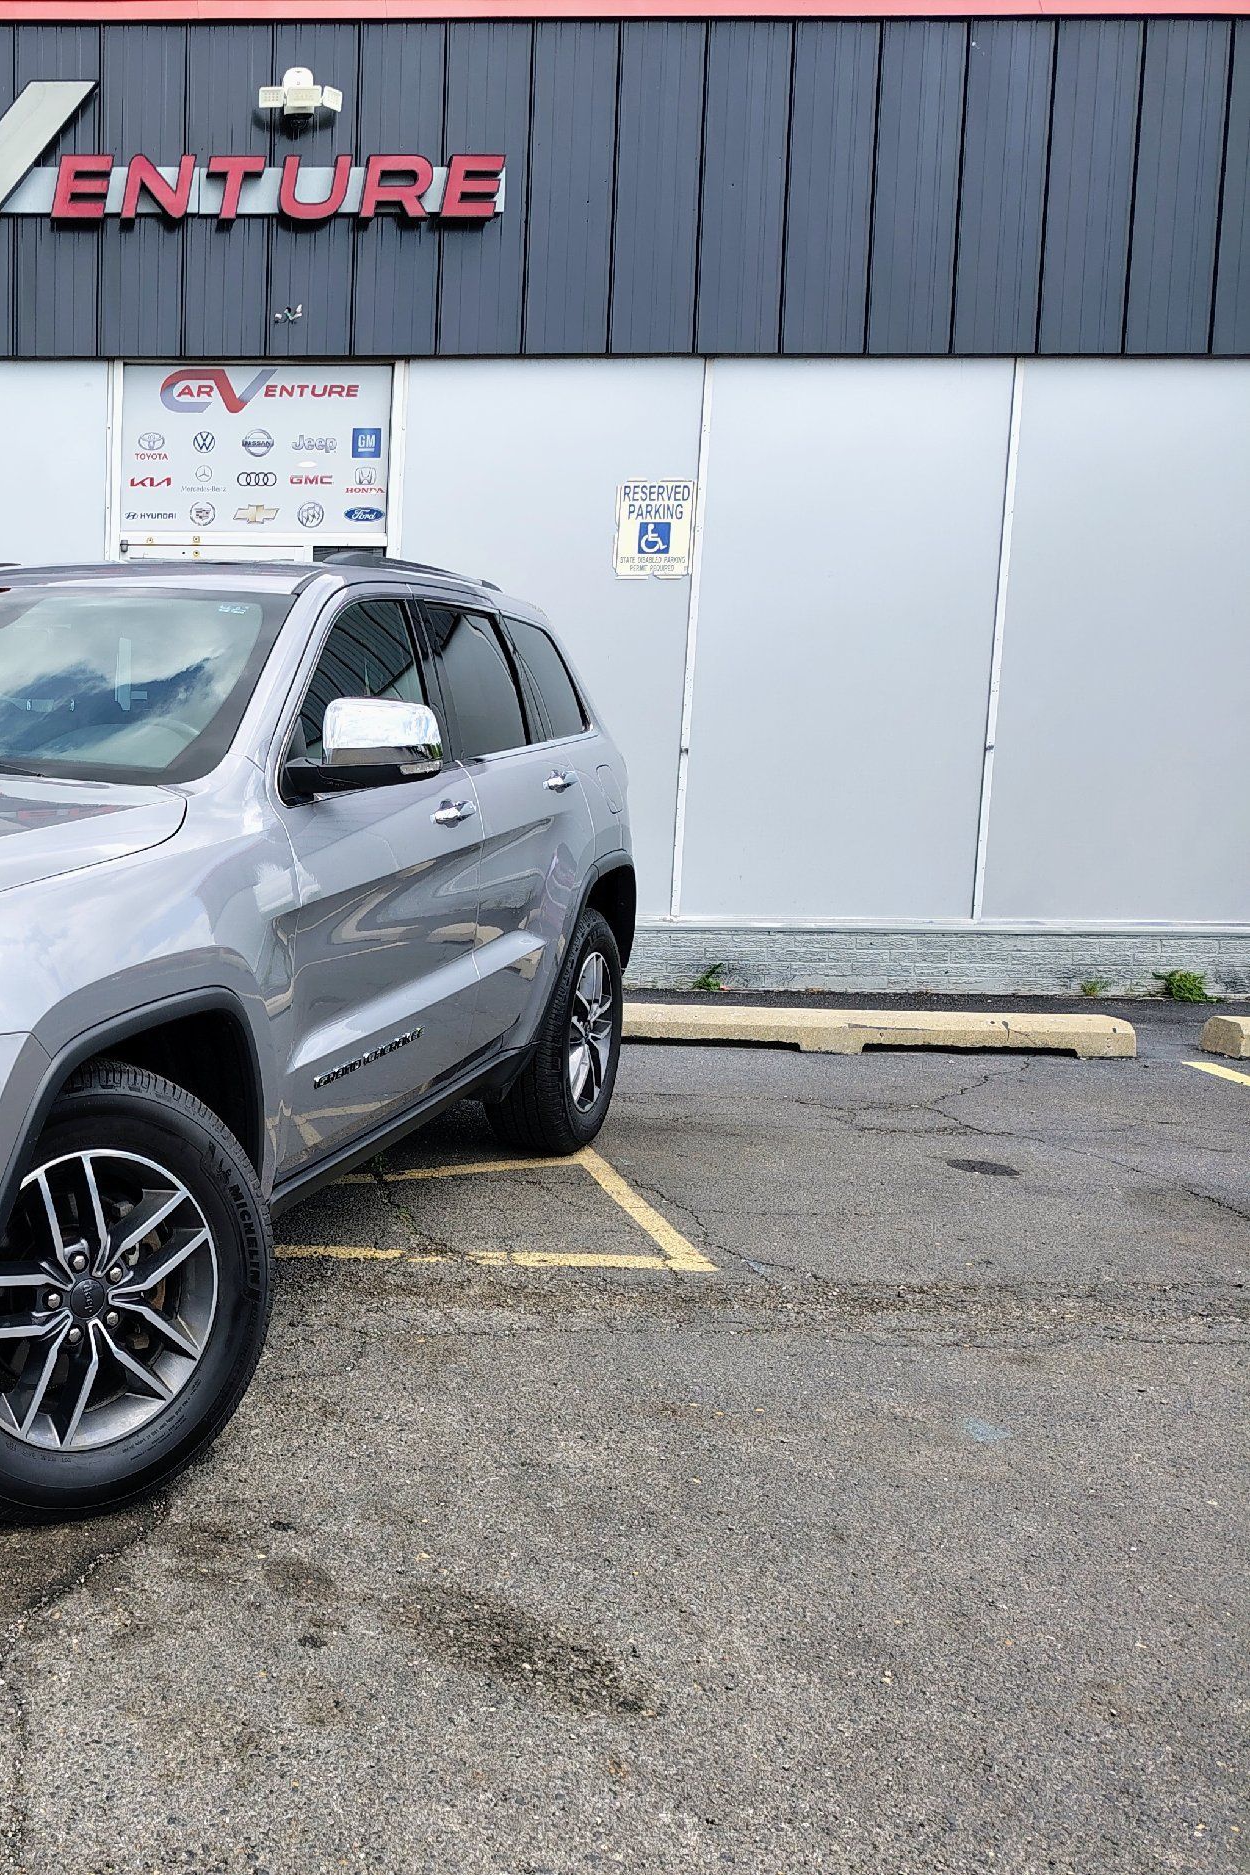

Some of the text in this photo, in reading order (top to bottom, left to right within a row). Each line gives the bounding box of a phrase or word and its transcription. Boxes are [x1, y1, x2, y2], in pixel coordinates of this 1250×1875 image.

[292, 435, 337, 453] Jeep
[130, 477, 171, 487] KIA
[290, 475, 333, 485] GMC
[623, 485, 690, 501] RESERVED
[351, 509, 377, 519] Ford
[628, 504, 684, 520] PARKING
